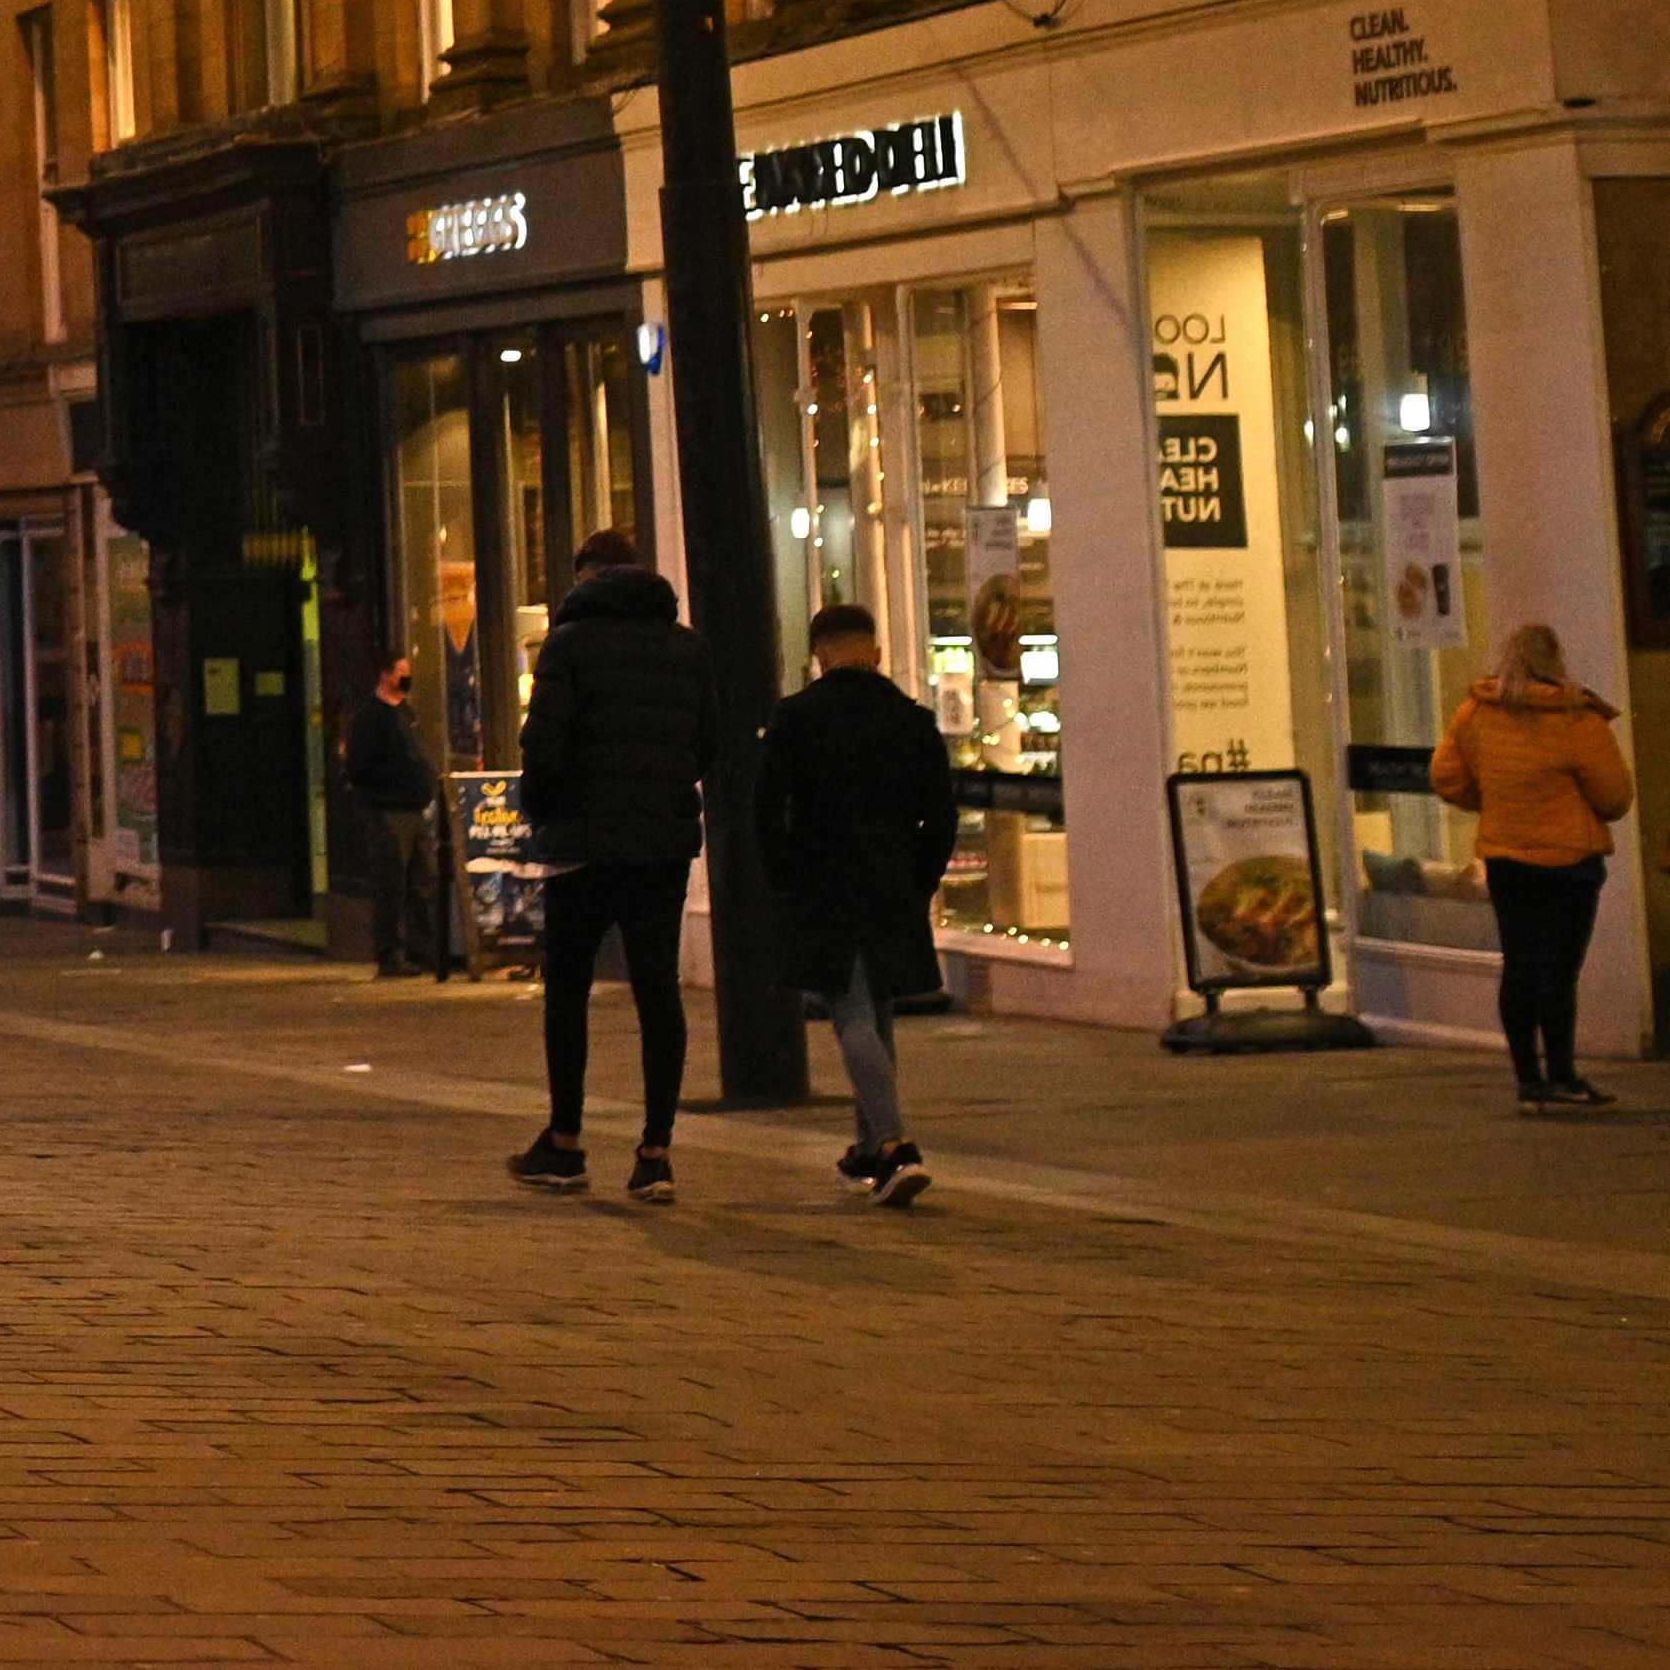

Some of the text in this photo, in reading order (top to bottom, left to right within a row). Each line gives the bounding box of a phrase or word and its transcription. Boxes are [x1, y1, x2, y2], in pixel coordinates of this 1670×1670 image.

[1350, 7, 1410, 41] CLEAN.
[1352, 38, 1428, 74] HEALTHY.
[1354, 66, 1458, 107] NUTRITIOUS.
